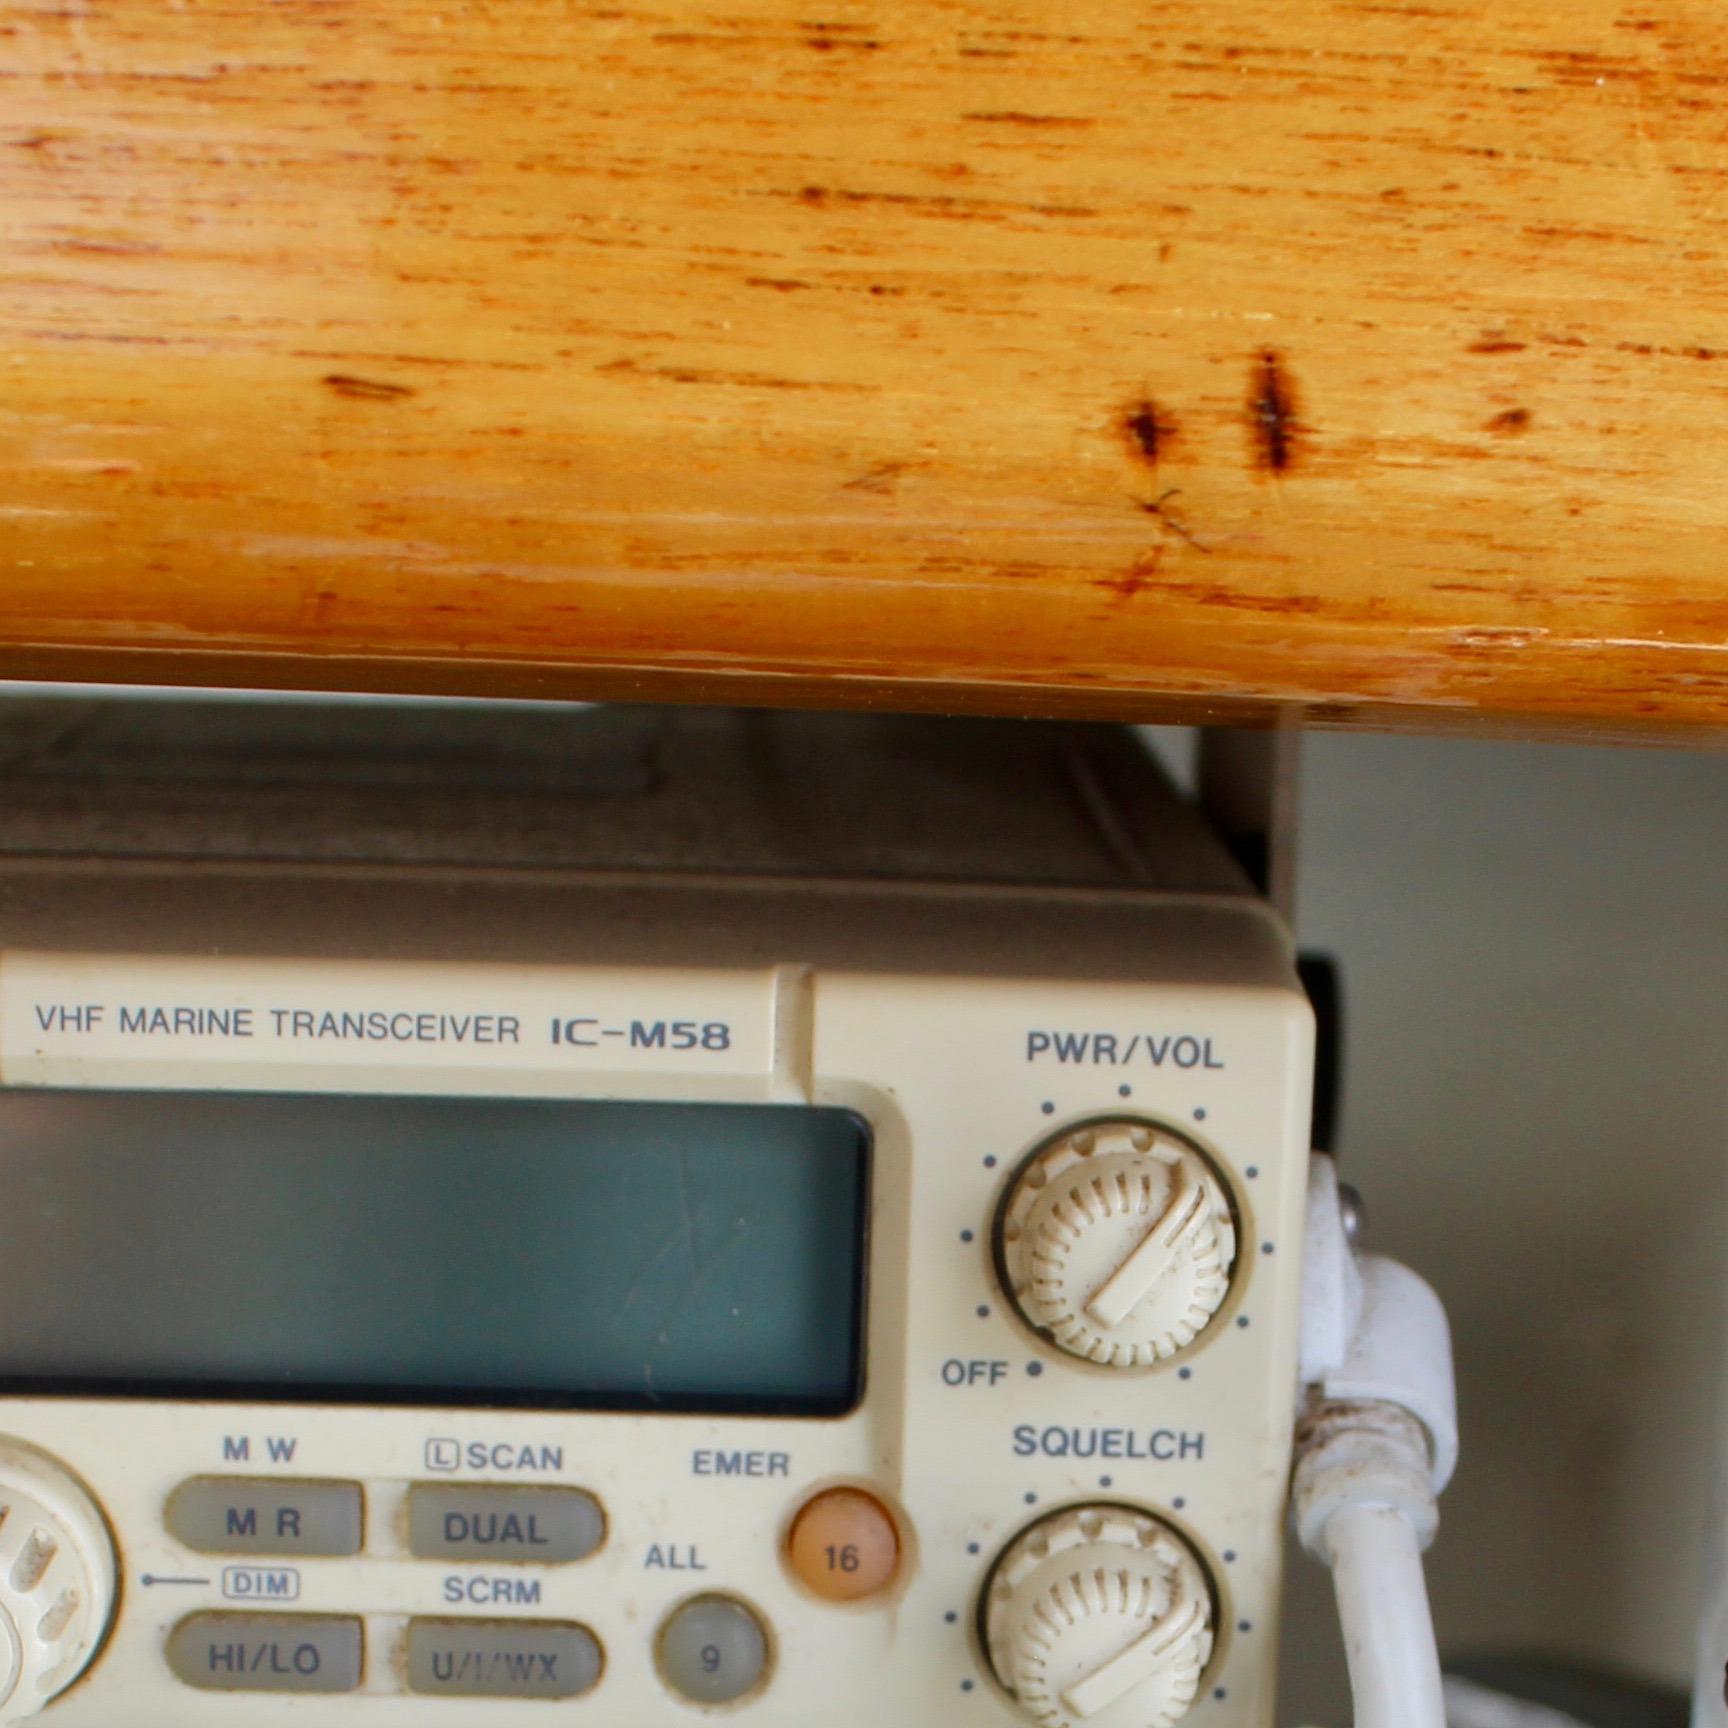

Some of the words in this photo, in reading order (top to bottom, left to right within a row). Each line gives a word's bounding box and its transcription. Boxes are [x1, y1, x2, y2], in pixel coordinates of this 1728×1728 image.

[34, 1004, 105, 1034] VHF
[118, 1006, 254, 1038] MARINE
[270, 1009, 521, 1045] TRANSCEIVER
[550, 1017, 732, 1052] IC-M58
[1025, 1031, 1225, 1070] PWR/VOL
[941, 1358, 1009, 1387] OFF
[466, 1443, 564, 1471] SCAN
[1012, 1424, 1205, 1461] SQUELCH
[691, 1449, 791, 1477] EMER
[443, 1512, 549, 1545] DUAL
[643, 1544, 708, 1571] ALL
[824, 1544, 860, 1573] 16
[232, 1571, 290, 1595] DIM
[443, 1576, 542, 1604] SCRM
[207, 1643, 322, 1674] HI/LO
[699, 1644, 722, 1674] 9
